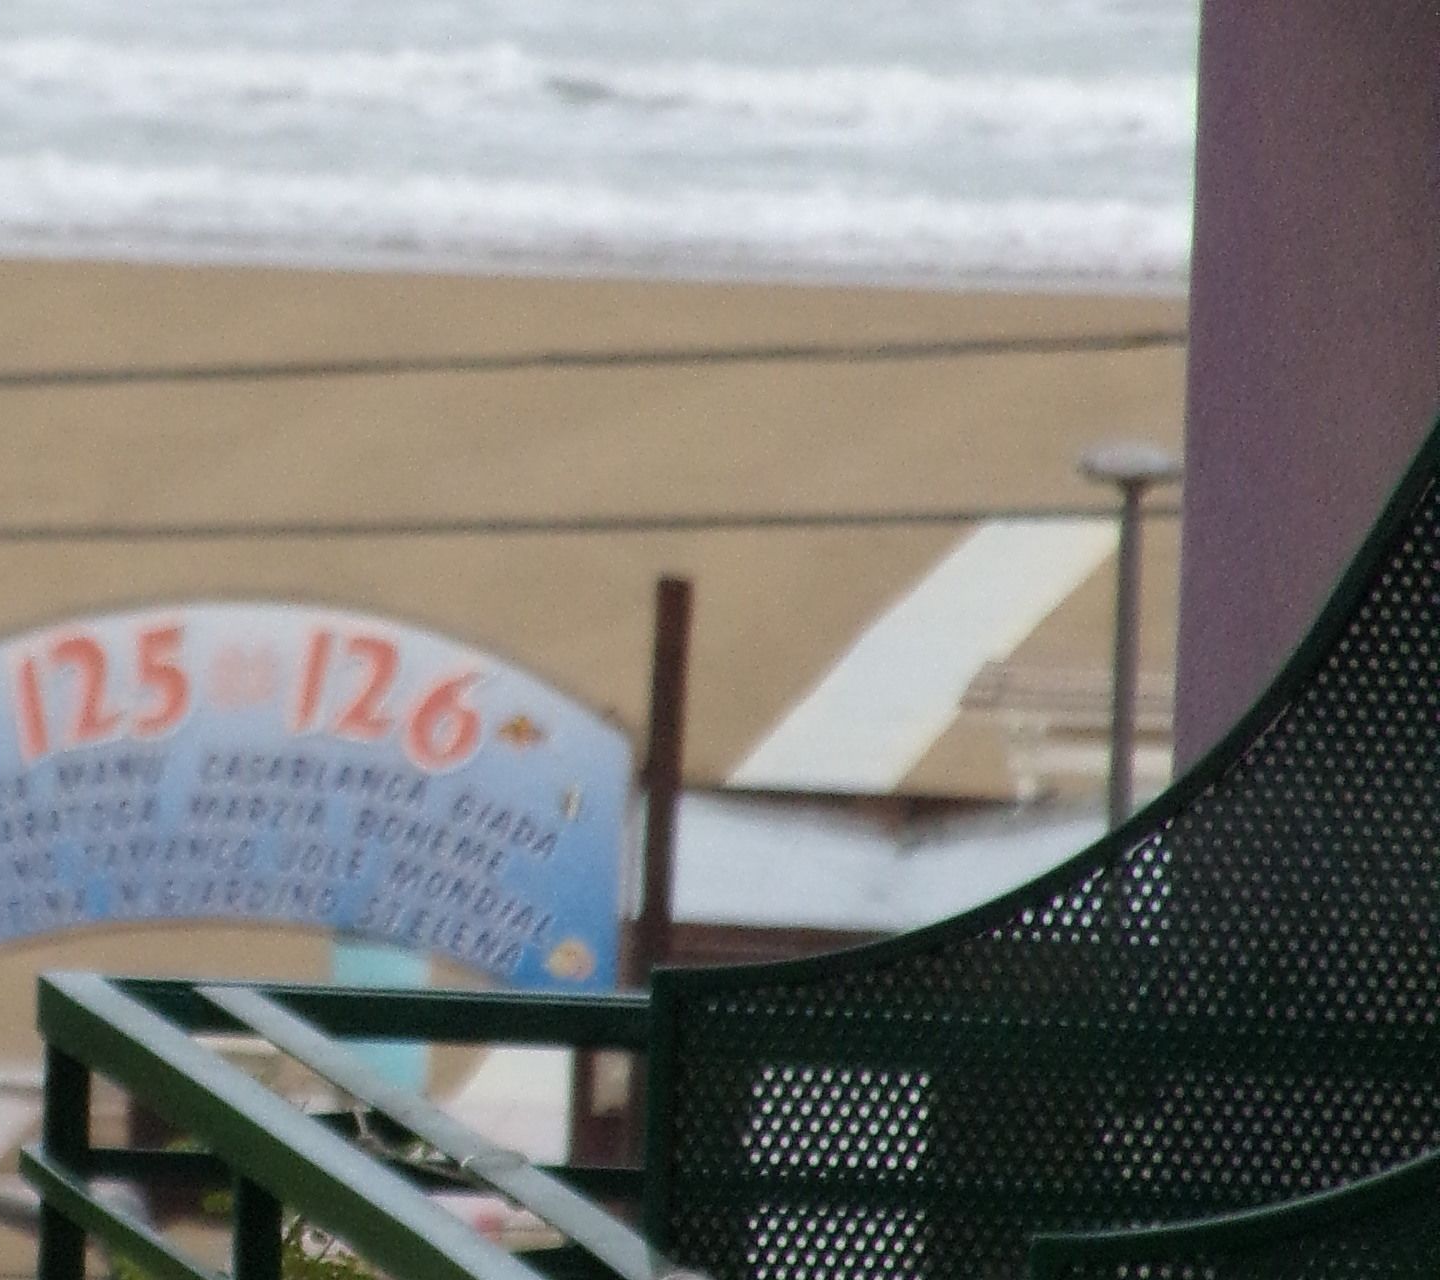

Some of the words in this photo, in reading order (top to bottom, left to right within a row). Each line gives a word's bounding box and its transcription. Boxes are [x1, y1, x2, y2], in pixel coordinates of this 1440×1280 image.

[15, 625, 190, 762] 125
[292, 628, 482, 768] 126
[200, 754, 430, 802] CASABLANCA
[451, 786, 559, 858] GIADA
[355, 808, 506, 872] BOHEME
[390, 859, 554, 945] MONDIAL
